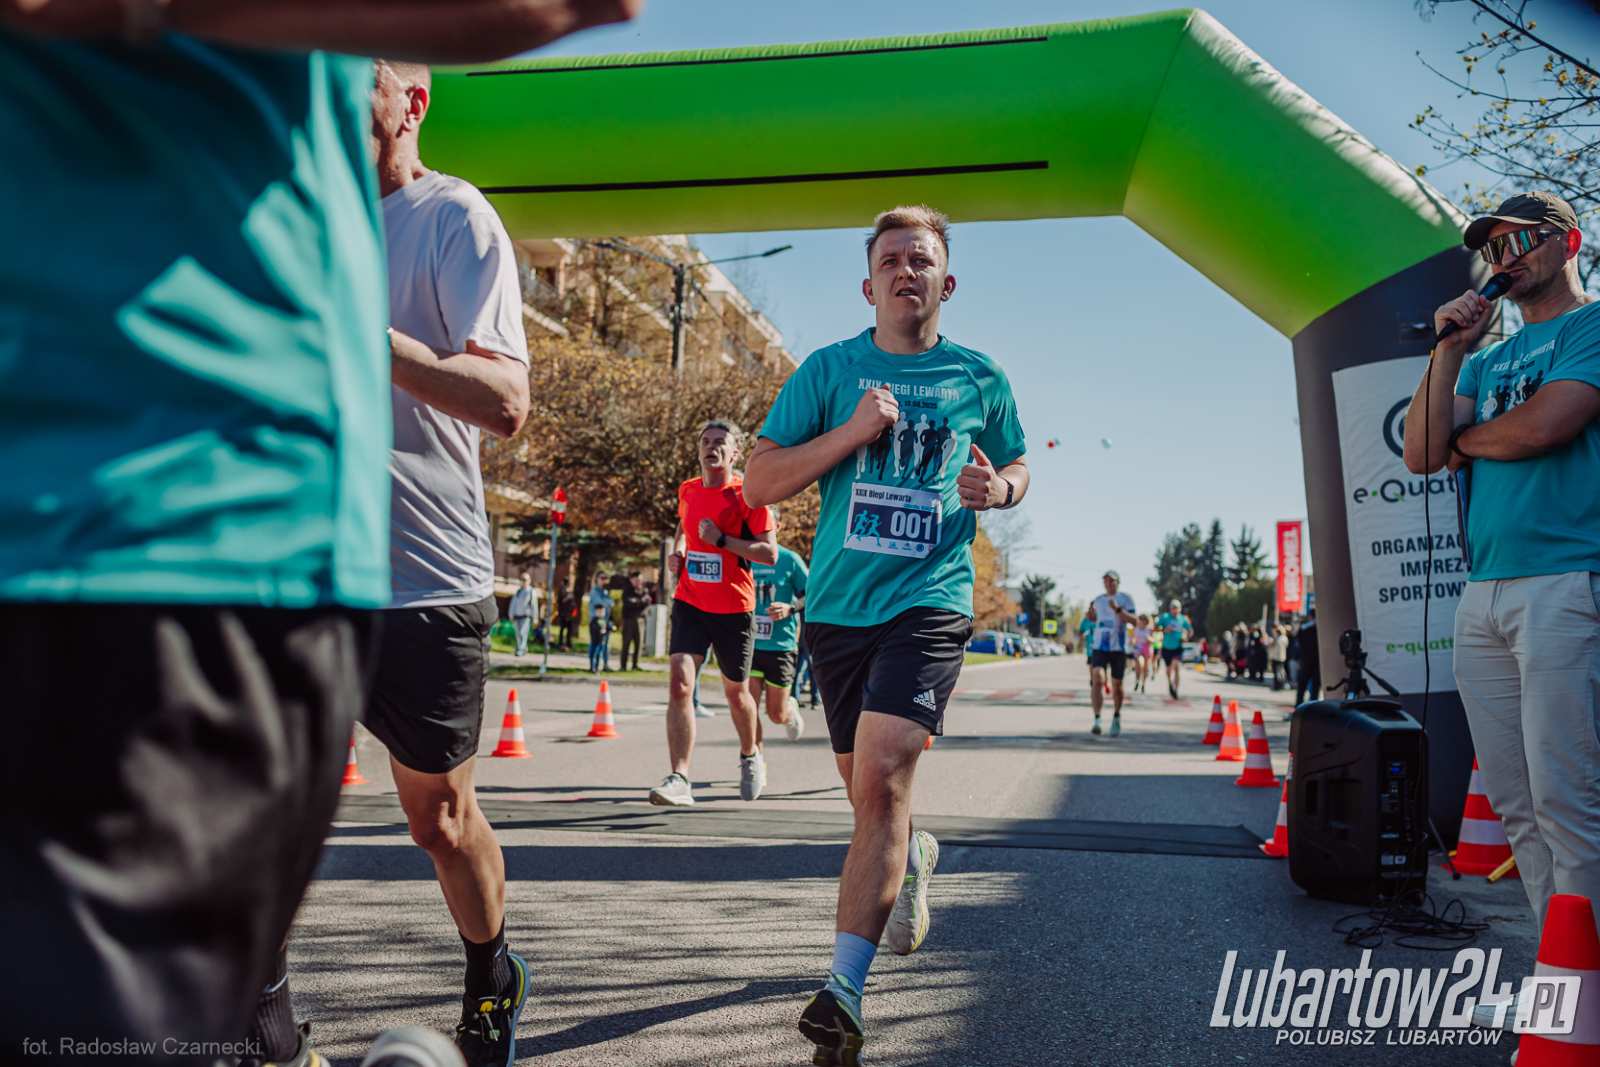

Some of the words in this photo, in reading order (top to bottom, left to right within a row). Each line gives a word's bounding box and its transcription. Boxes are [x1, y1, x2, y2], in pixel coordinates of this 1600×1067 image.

[891, 384, 910, 396] IEGI
[890, 510, 932, 540] 001
[700, 563, 718, 575] 158
[1378, 581, 1467, 604] SPORTOW
